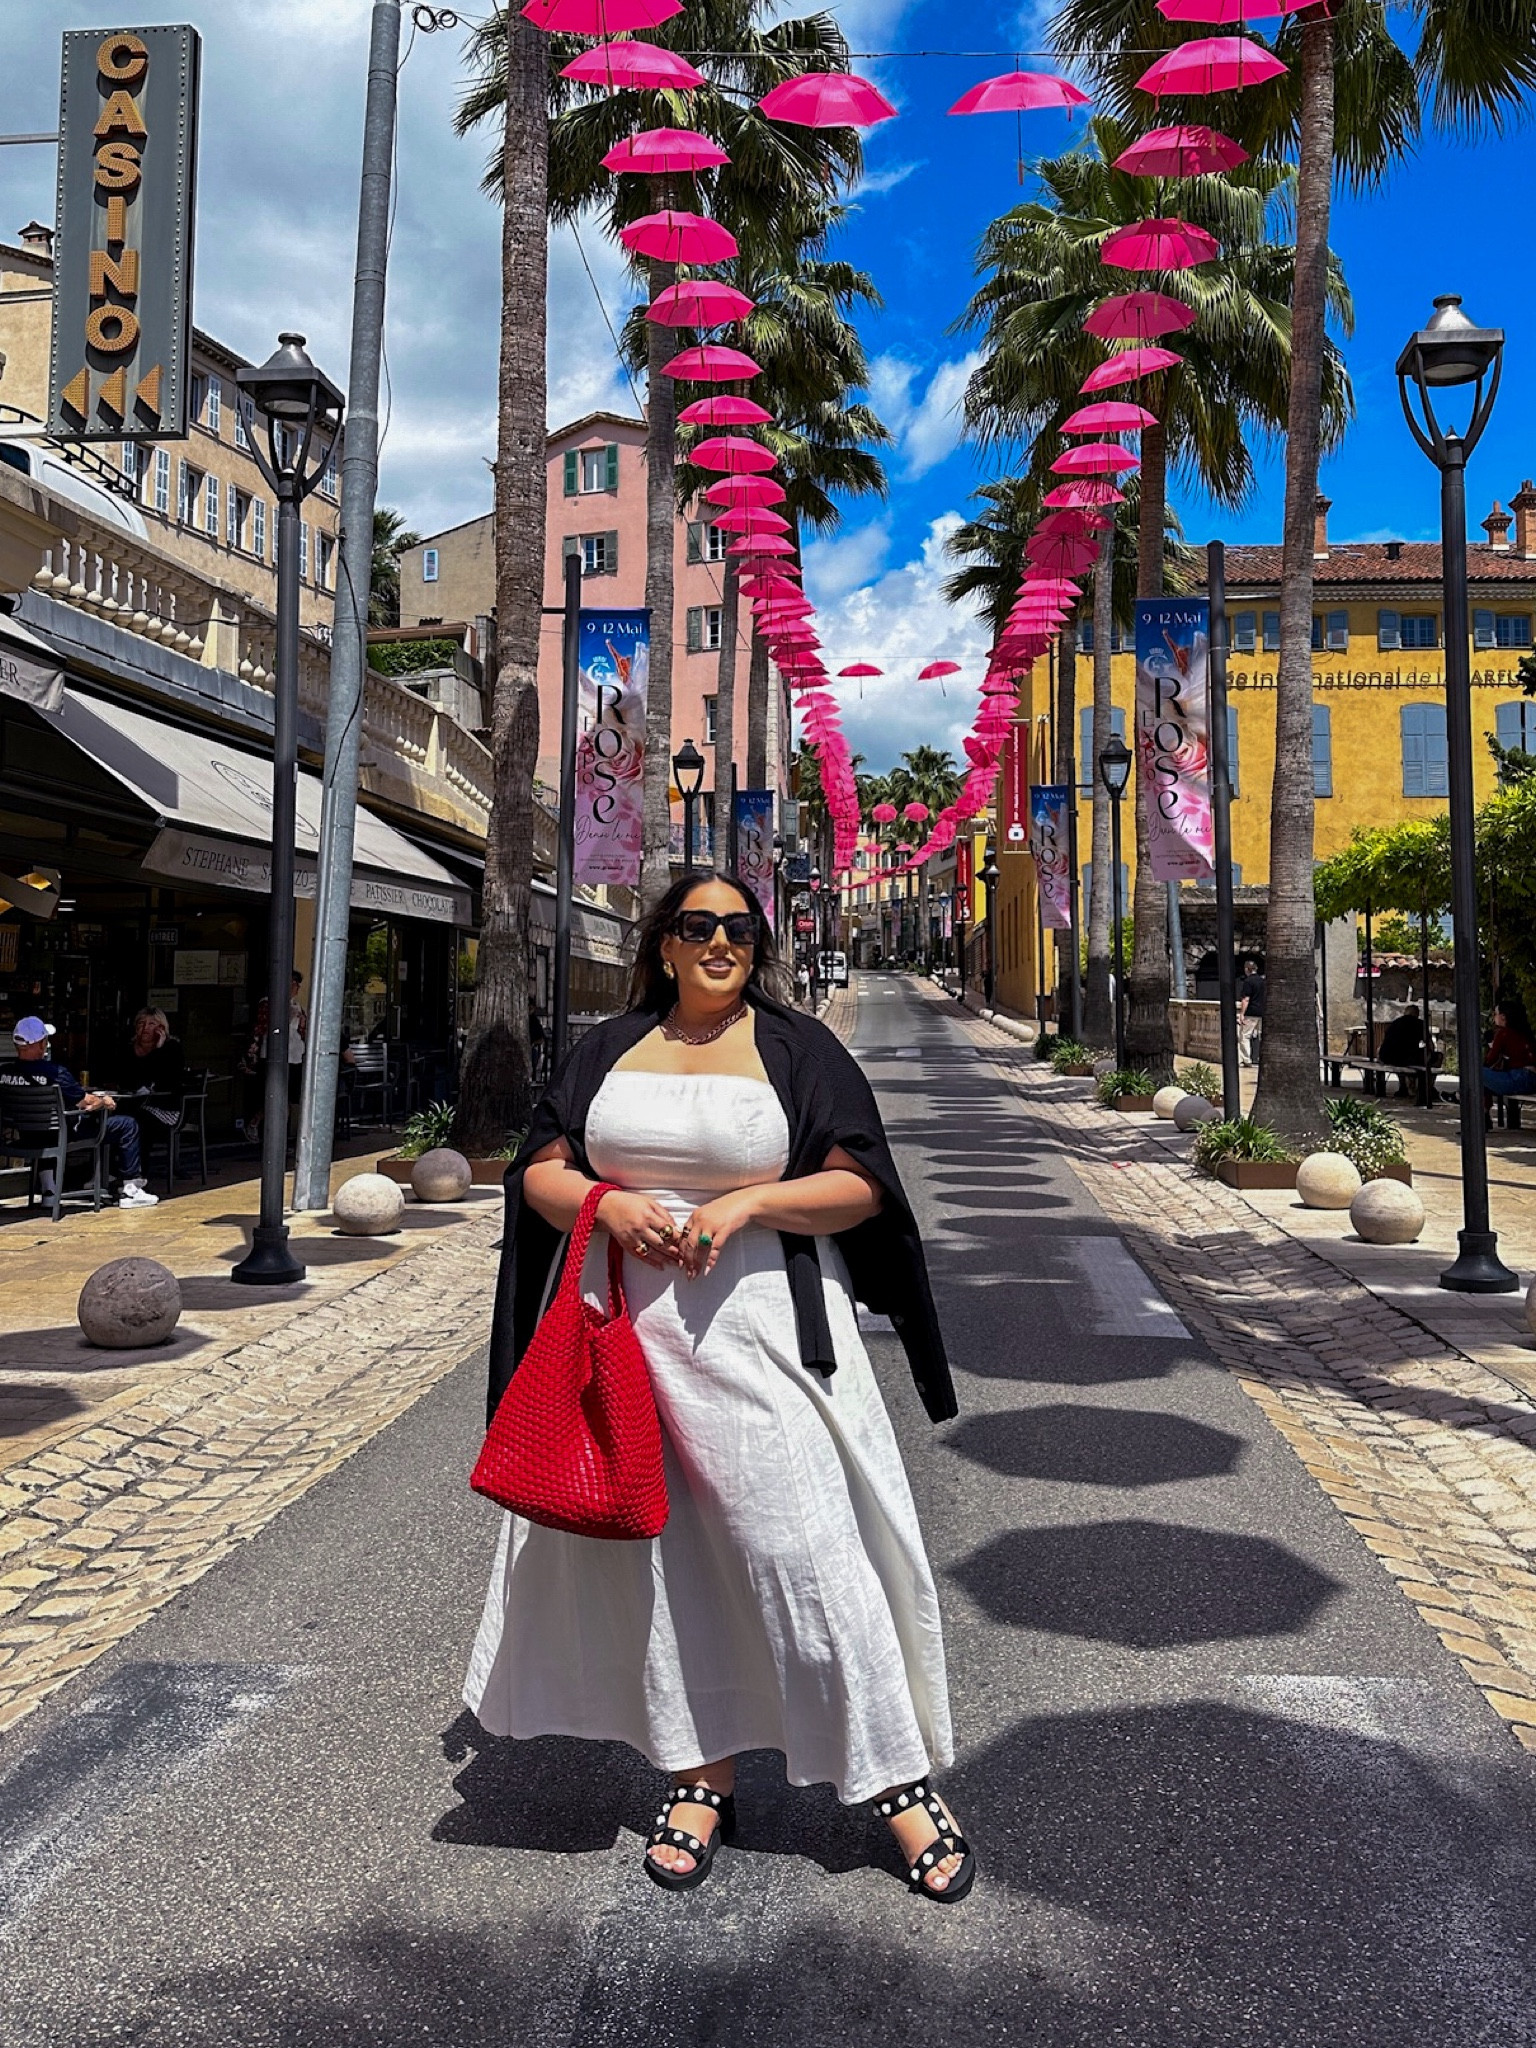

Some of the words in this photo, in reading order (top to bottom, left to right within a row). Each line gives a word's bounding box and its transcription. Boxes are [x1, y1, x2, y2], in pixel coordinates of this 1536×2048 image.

[86, 34, 148, 354] CASINO
[586, 622, 596, 634] 9
[603, 622, 614, 634] 12
[617, 622, 643, 634] Mai
[1142, 613, 1152, 624] 9
[1160, 612, 1171, 624] 12
[1174, 612, 1201, 624] Mai
[1406, 666, 1432, 690] de
[182, 846, 250, 877] STEPHANE
